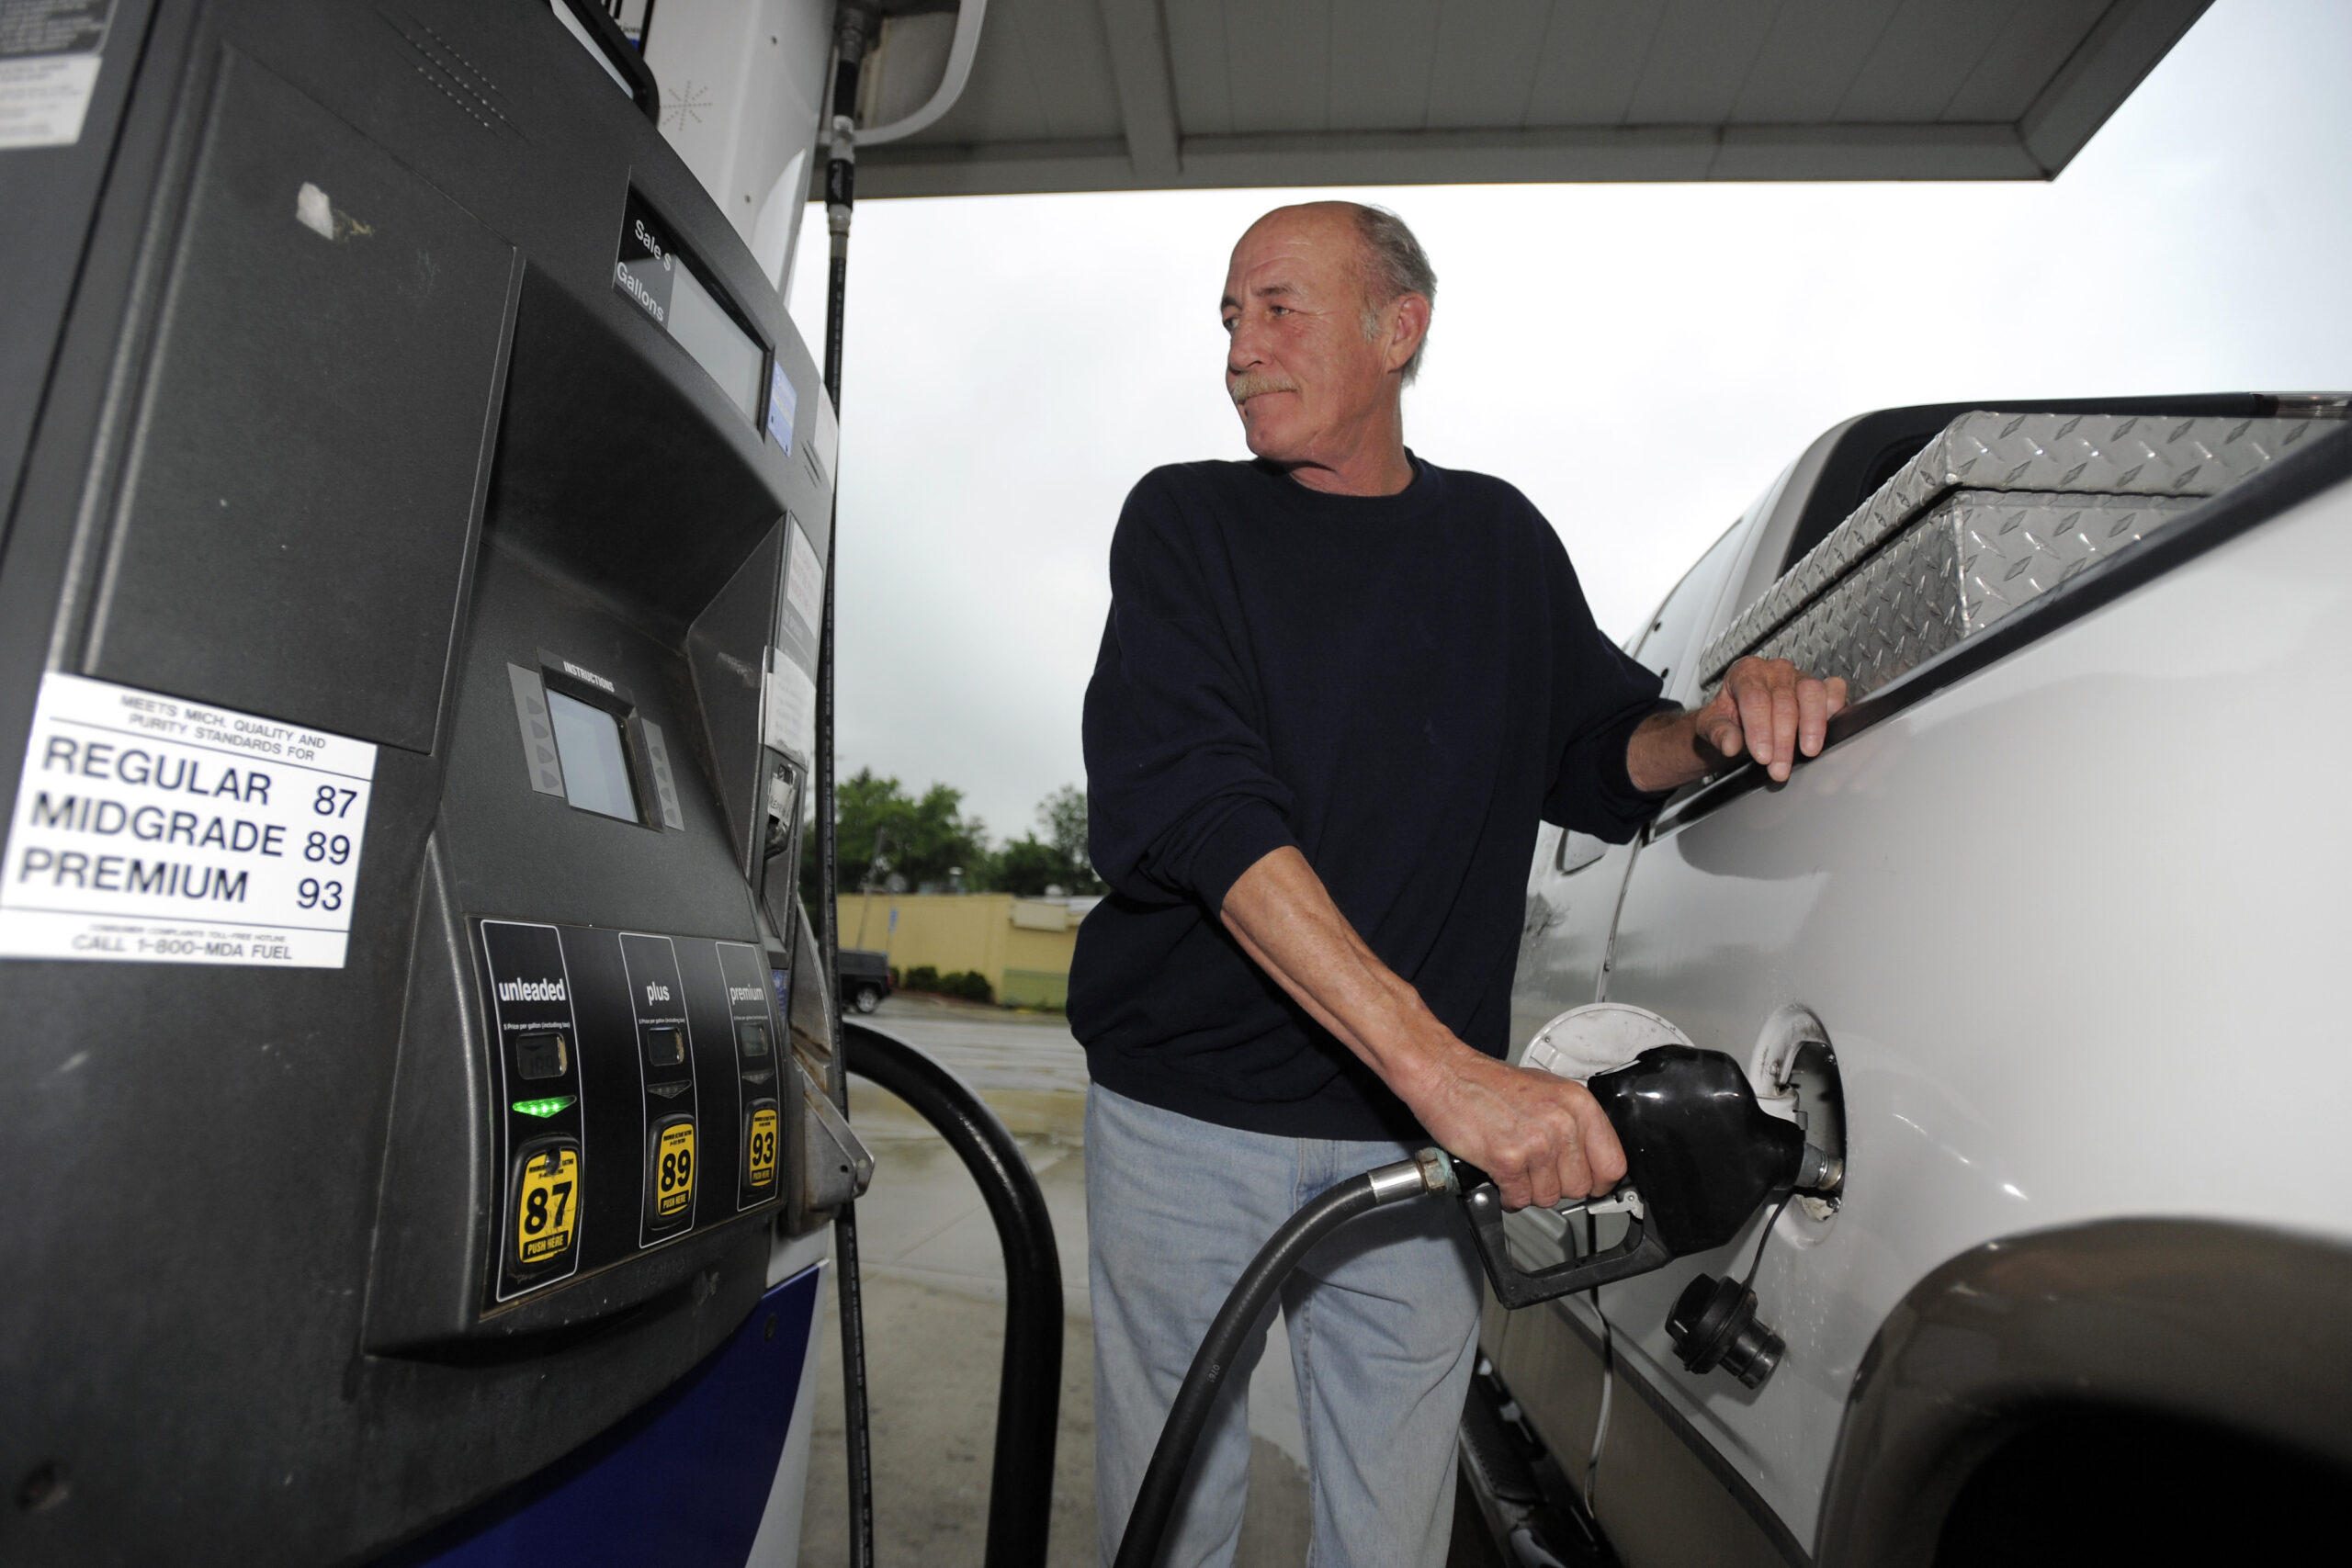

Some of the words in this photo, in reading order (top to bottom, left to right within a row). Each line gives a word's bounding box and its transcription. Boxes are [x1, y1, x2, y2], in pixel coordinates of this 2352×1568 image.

[635, 220, 662, 260] Sale
[617, 262, 663, 321] Gallons
[563, 660, 615, 693] INSTRUCTIONS
[120, 694, 177, 716] MEETS
[185, 708, 227, 728] MICH.
[233, 720, 294, 741] QUALITY
[299, 734, 326, 750] AND
[130, 714, 187, 734] PURITY
[195, 727, 281, 754] STANDARDS
[287, 746, 314, 761] FOR
[42, 735, 272, 806] REGULAR
[313, 785, 357, 818] 87
[29, 791, 287, 858] MIDGRADE
[303, 831, 351, 865] 89
[17, 847, 249, 903] PREMIUM
[297, 879, 343, 911] 93
[72, 934, 127, 952] CALL
[137, 938, 243, 957] 1-800-MDA
[251, 944, 292, 960] FUEL
[498, 976, 566, 1001] unleaded
[647, 981, 670, 1006] plus
[729, 984, 764, 1006] premium
[752, 1132, 774, 1167] 93
[661, 1149, 691, 1192] 89
[524, 1180, 572, 1235] 87
[663, 1197, 675, 1210] PUSH
[675, 1192, 686, 1204] HERE
[527, 1240, 546, 1256] PUSH
[548, 1235, 564, 1249] HERE
